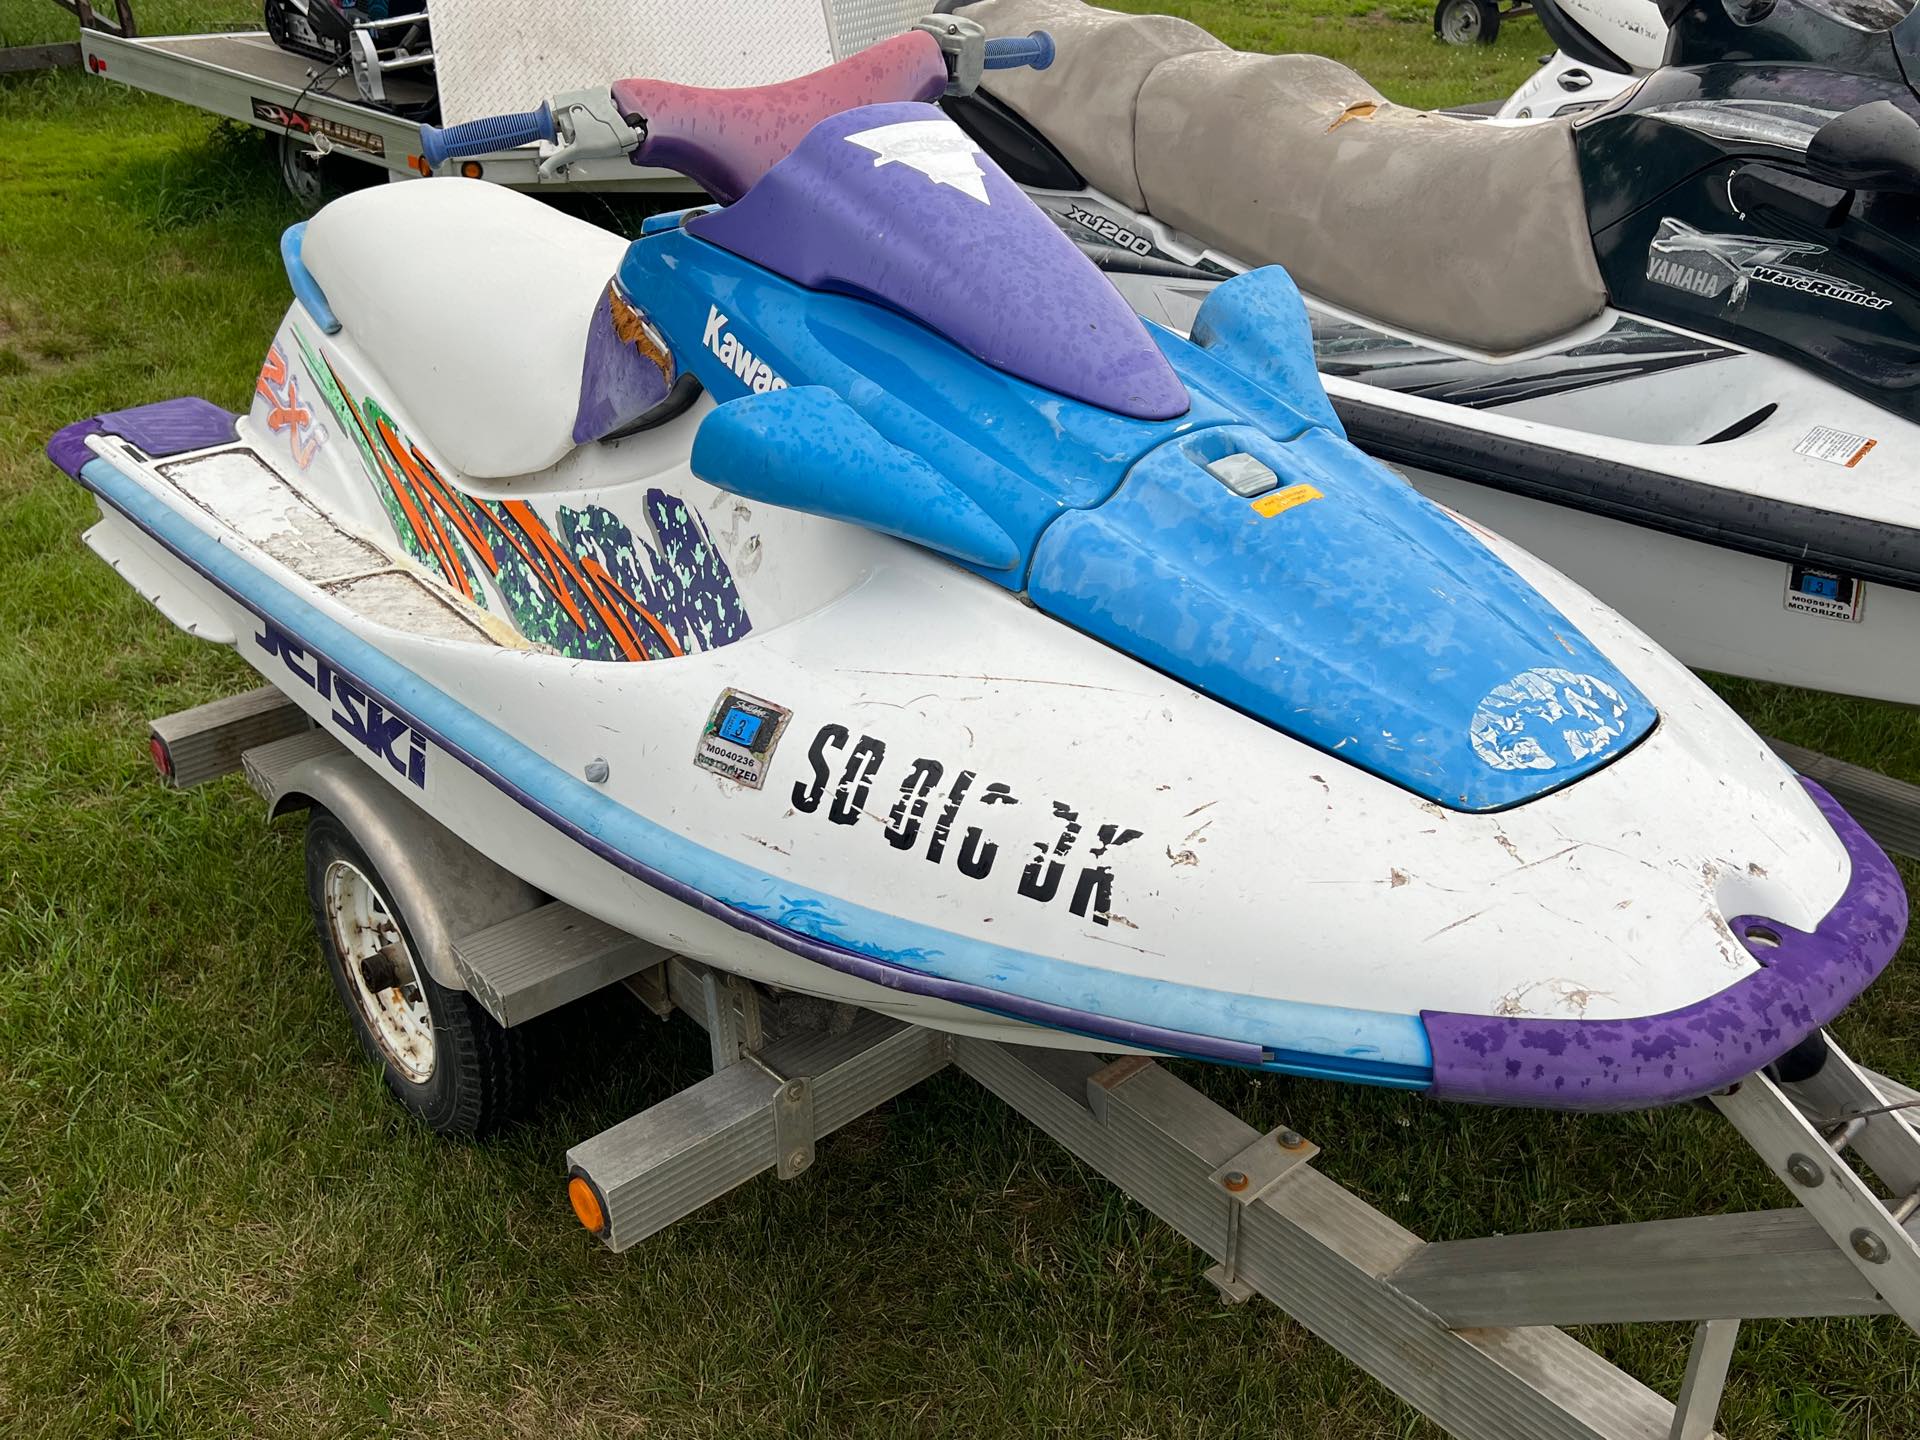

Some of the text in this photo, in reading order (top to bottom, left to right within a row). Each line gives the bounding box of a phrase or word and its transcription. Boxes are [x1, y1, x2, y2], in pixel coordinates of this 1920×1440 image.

[1066, 204, 1152, 257] XL1200
[1649, 257, 1719, 296] YAMAHA
[1750, 265, 1892, 310] WaveRunner
[1788, 603, 1850, 620] MOTORIZED
[706, 744, 755, 767] M0040236
